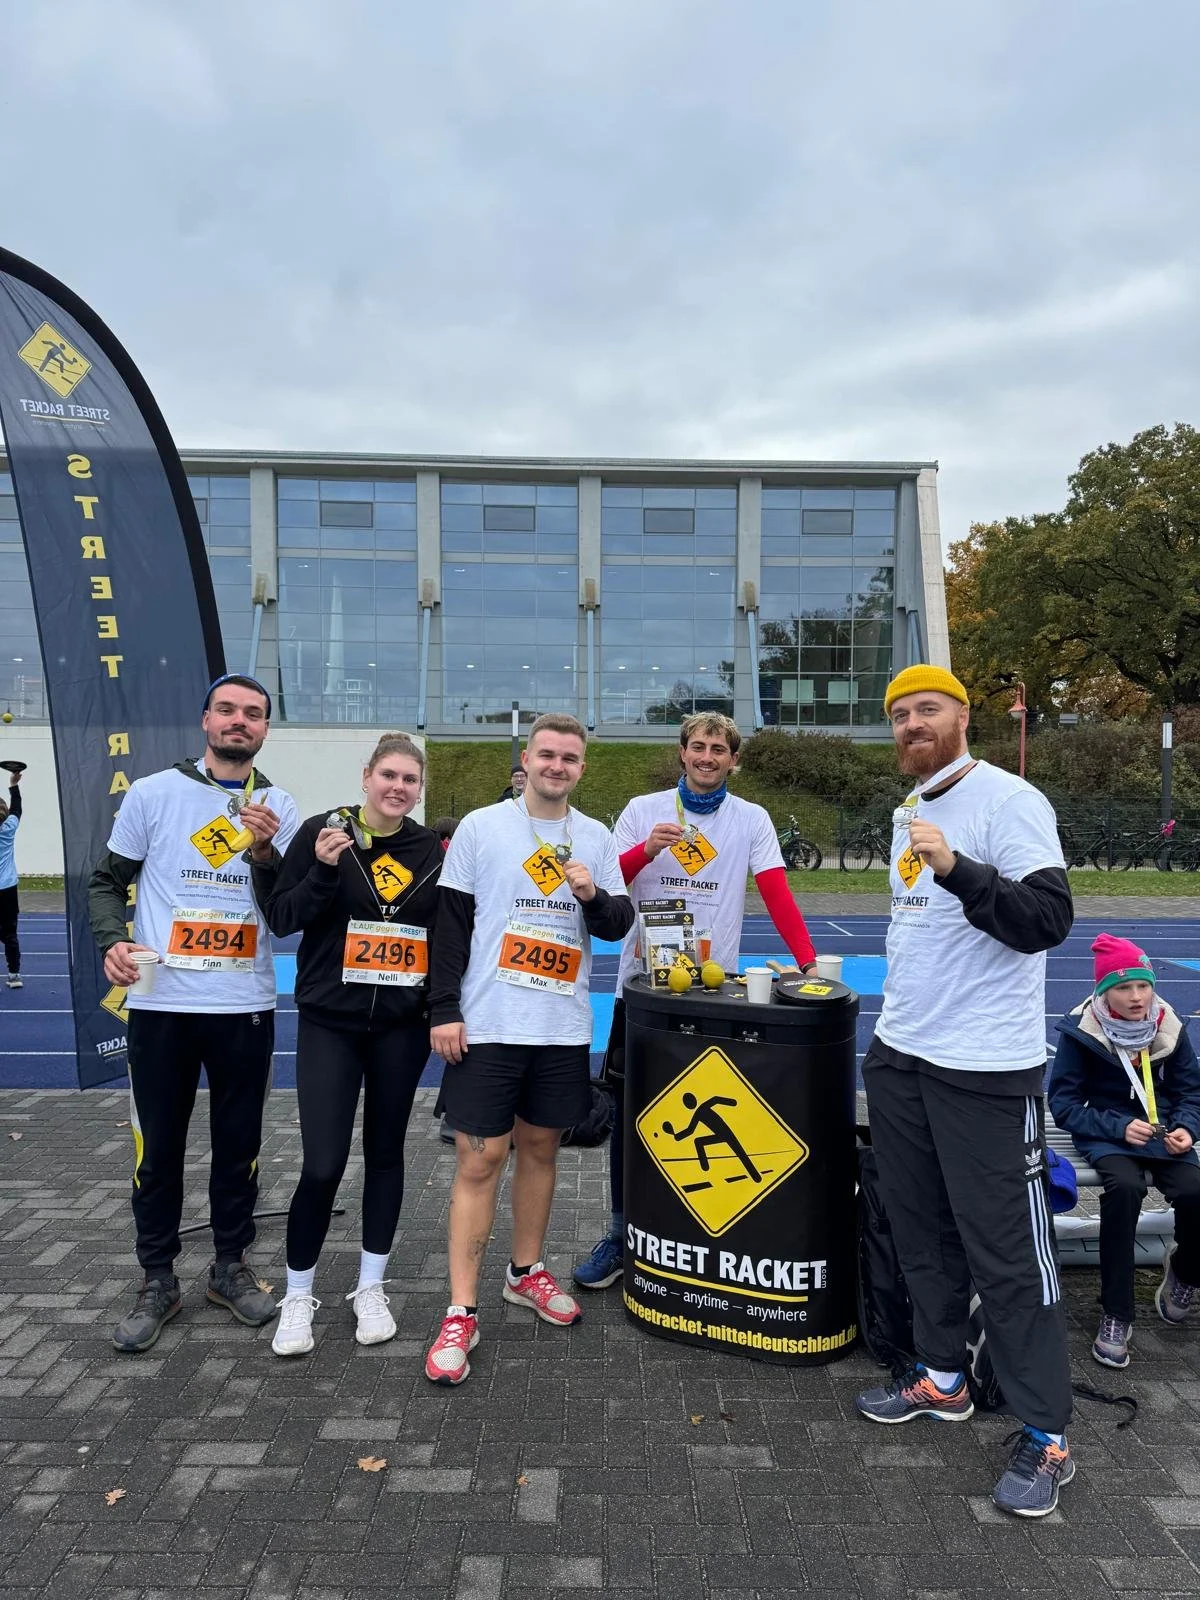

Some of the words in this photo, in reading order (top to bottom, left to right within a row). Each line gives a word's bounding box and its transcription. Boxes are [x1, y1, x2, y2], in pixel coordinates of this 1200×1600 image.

[180, 869, 214, 881] STREET
[216, 873, 249, 885] RACKET
[660, 876, 689, 887] STREET
[691, 880, 719, 890] RACKET
[515, 898, 545, 908] STREET
[547, 900, 577, 912] RACKET
[198, 911, 223, 919] gegen
[180, 927, 245, 952] 2494
[532, 929, 555, 938] gegen
[355, 940, 416, 967] 2496
[510, 941, 570, 975] 2495
[202, 958, 222, 968] Finn
[378, 973, 398, 982] Nelli
[530, 976, 548, 988] Max
[626, 1223, 710, 1275] STREET
[719, 1250, 827, 1290] RACKET
[634, 1273, 667, 1297] anyone
[683, 1290, 729, 1312] anytime
[746, 1303, 807, 1322] anywhere
